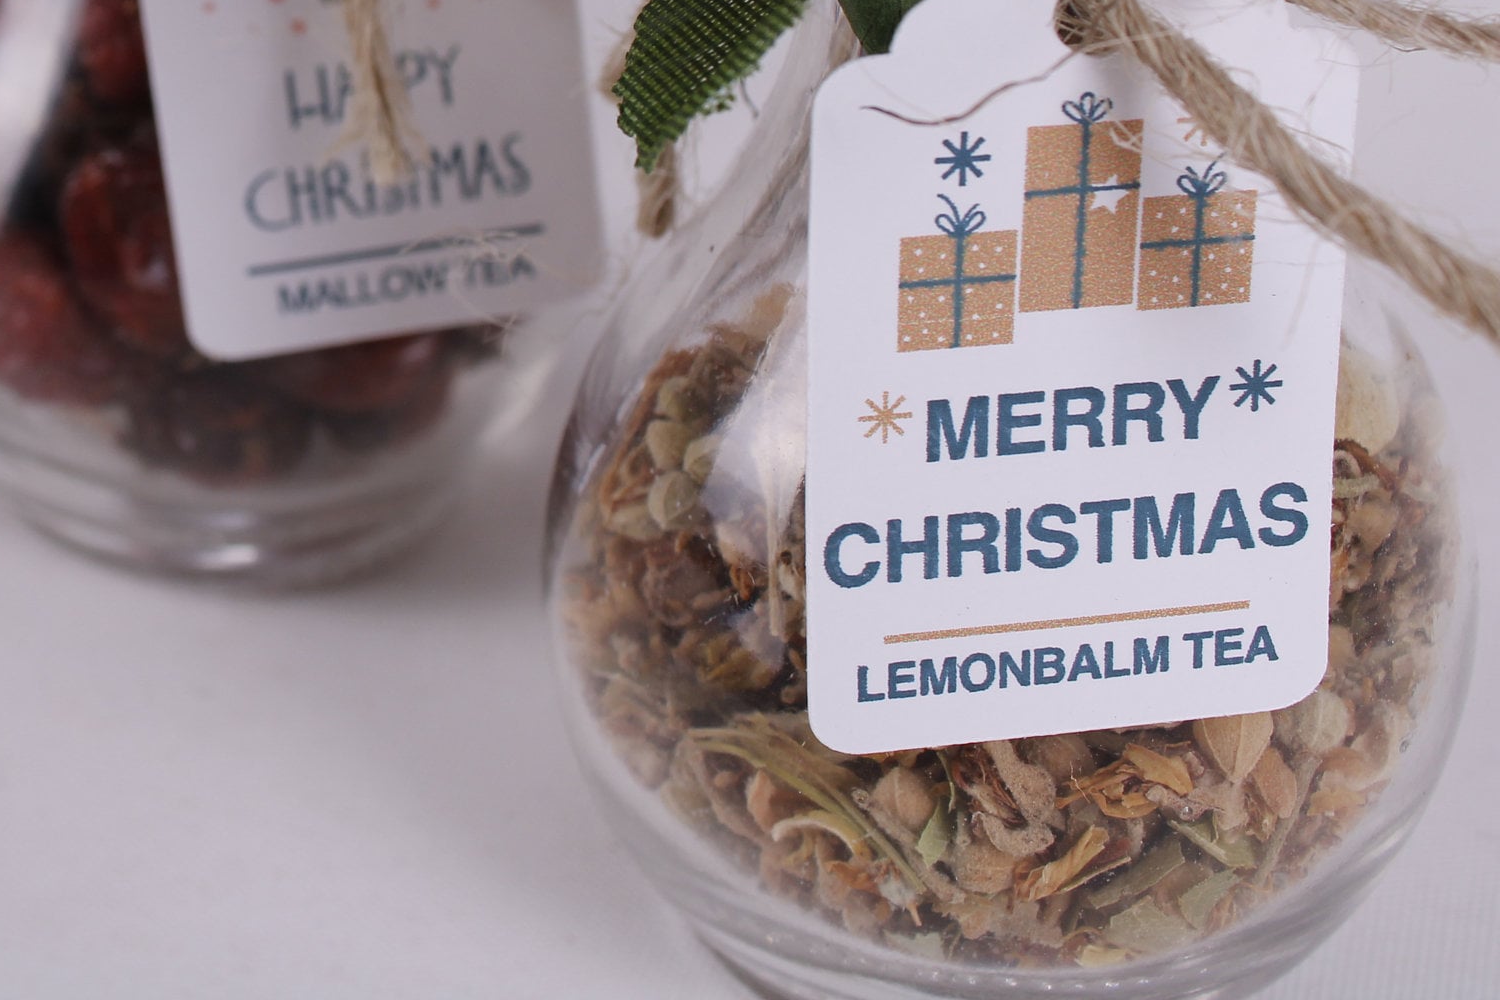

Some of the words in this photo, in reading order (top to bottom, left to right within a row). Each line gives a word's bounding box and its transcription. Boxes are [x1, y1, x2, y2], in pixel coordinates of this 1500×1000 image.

[278, 262, 451, 316] MALLOW
[462, 252, 538, 289] TEA
[925, 375, 1220, 463] MERRY
[822, 482, 1309, 589] CHRISTMAS
[856, 636, 1170, 704] LEMONBALM
[1183, 625, 1279, 670] TEA
